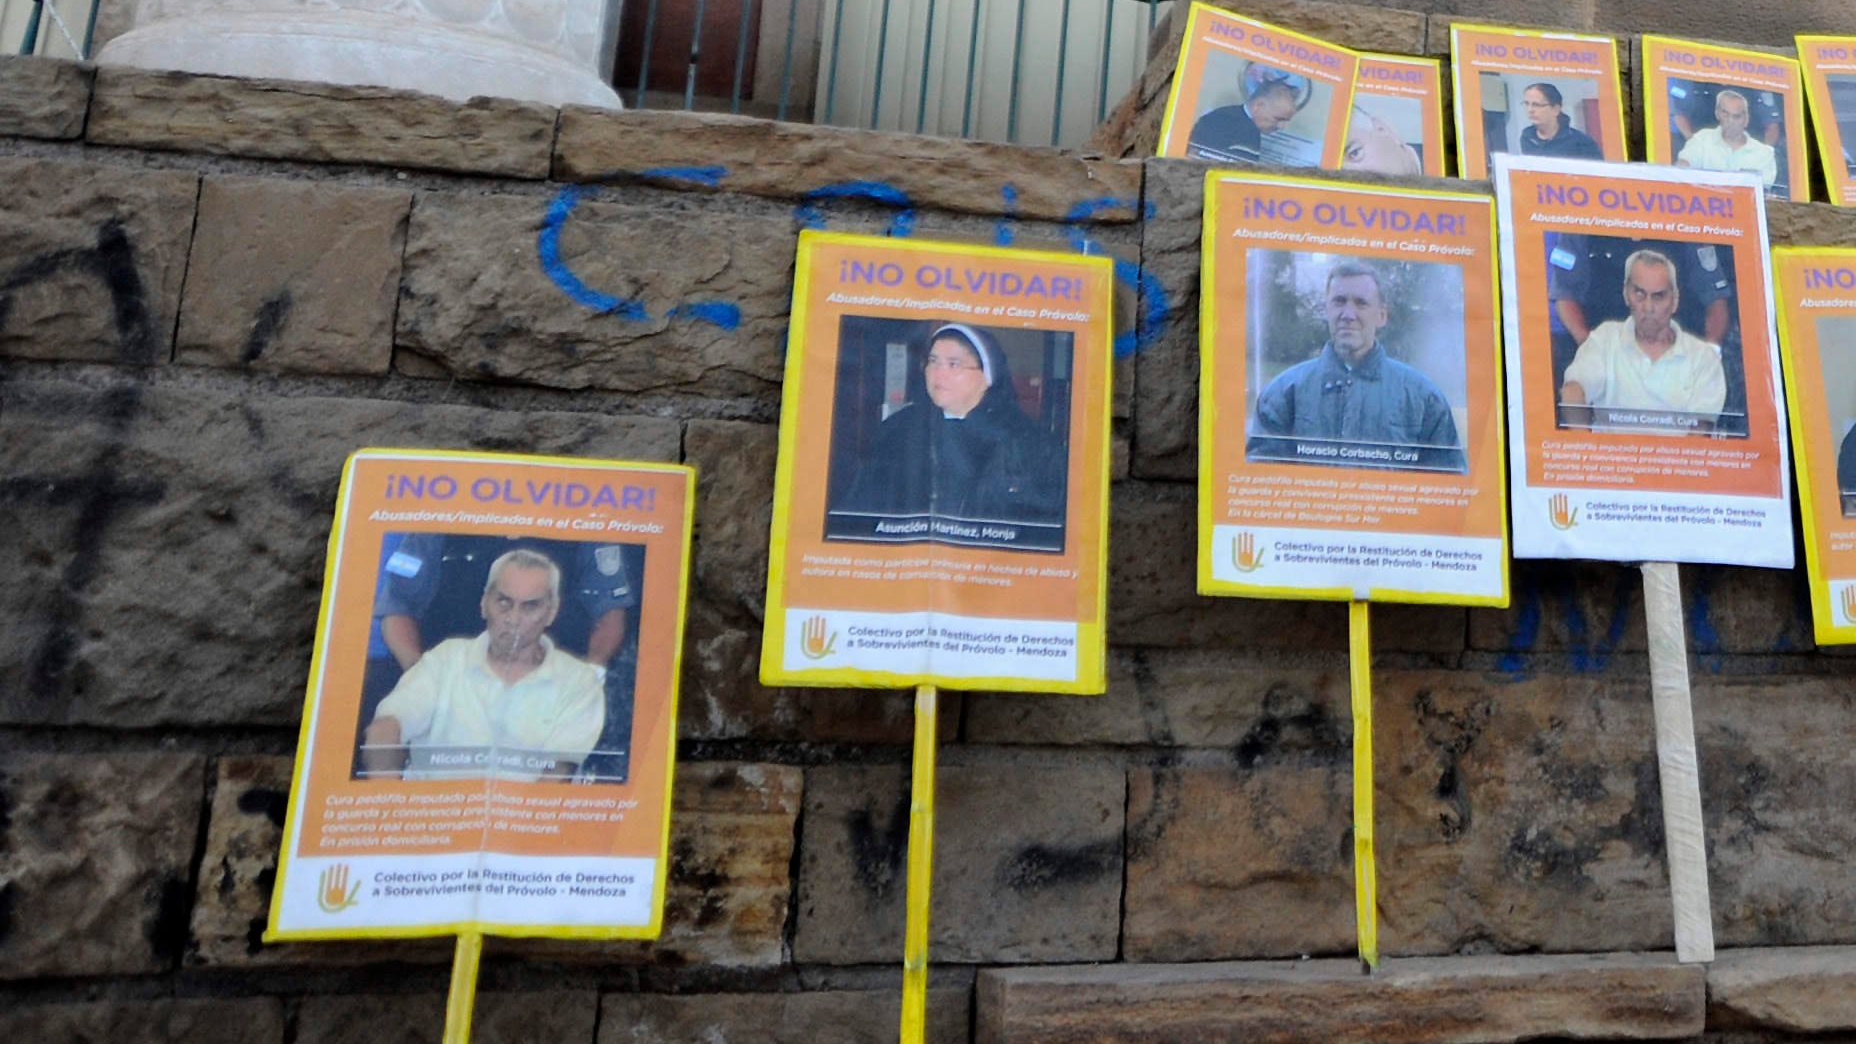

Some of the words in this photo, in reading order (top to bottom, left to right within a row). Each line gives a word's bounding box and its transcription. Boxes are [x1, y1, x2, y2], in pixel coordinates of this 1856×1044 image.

[1210, 20, 1244, 40] ¡NO
[1250, 33, 1341, 68] OLVIDAR!
[1475, 43, 1506, 57] ¡NO
[1513, 47, 1597, 63] OLVIDAR!
[1816, 47, 1847, 59] ¡NO
[1359, 67, 1423, 82] VIDAR!
[1664, 50, 1694, 65] ¡NO
[1700, 56, 1785, 78] OLVIDAR!
[1536, 184, 1588, 206] ¡NO
[1598, 188, 1732, 218] OLVIDAR!
[1242, 198, 1302, 221] ¡NO
[1312, 203, 1465, 235] OLVIDAR!
[1529, 212, 1649, 229] Abusadores/implicados
[1650, 222, 1664, 230] en
[1664, 222, 1675, 231] el
[1676, 222, 1701, 234] Caso
[1231, 228, 1367, 247] Abusadores/implicados
[1368, 239, 1384, 248] en
[1385, 240, 1397, 250] el
[1398, 239, 1426, 253] Caso
[840, 260, 903, 286] ¡NO
[916, 265, 1083, 300] OLVIDAR!
[1803, 268, 1856, 289] ¡NO
[826, 292, 971, 313] Abusadores/implicados
[973, 305, 989, 315] en
[991, 306, 1004, 316] el
[1006, 306, 1036, 318] Caso
[1038, 308, 1090, 322] Próvolo:
[1295, 443, 1338, 457] Horacio
[1338, 446, 1392, 460] Corbacho,
[1393, 449, 1419, 461] Cura
[385, 475, 457, 499] ¡NO
[470, 478, 656, 510] OLVIDAR!
[1585, 500, 1630, 511] Colectivo
[1631, 503, 1647, 514] por
[1660, 503, 1710, 514] Restitución
[1711, 506, 1724, 515] de
[1725, 506, 1766, 518] Derechos
[1593, 511, 1662, 522] Sobrevivientes
[1663, 514, 1679, 523] del
[1680, 514, 1716, 525] Próvolo
[1722, 516, 1762, 528] Mendoza
[368, 509, 533, 526] Abusadores/implicados
[536, 516, 553, 527] en
[555, 518, 569, 529] el
[571, 518, 605, 531] Caso
[607, 519, 664, 534] Próvolo:
[875, 520, 928, 533] Asunción
[981, 526, 1016, 541] Monja
[1273, 540, 1324, 553] Colectivo
[1326, 544, 1345, 555] por
[1358, 544, 1417, 557] Restitución
[1418, 547, 1433, 557] de
[1434, 548, 1482, 560] Derechos
[1282, 552, 1361, 565] Sobrevivientes
[1362, 556, 1378, 566] del
[1381, 556, 1422, 568] Próvolo
[1430, 559, 1477, 571] Mendoza
[847, 625, 903, 638] Colectivo
[905, 627, 925, 640] por
[940, 627, 1001, 643] Restitución
[1003, 633, 1019, 643] de
[1021, 633, 1074, 646] Derechos
[856, 637, 941, 649] Sobrevivientes
[942, 640, 959, 652] del
[961, 642, 1005, 655] Próvolo
[1015, 645, 1067, 657] Mendoza
[373, 871, 437, 883] Colectivo
[441, 870, 464, 884] por
[482, 868, 553, 883] Restitución
[555, 872, 573, 883] de
[575, 871, 635, 884] Derechos
[383, 882, 482, 896] Sobrevivientes
[485, 883, 504, 894] del
[506, 884, 557, 896] Próvolo
[568, 885, 626, 897] Mendoza
